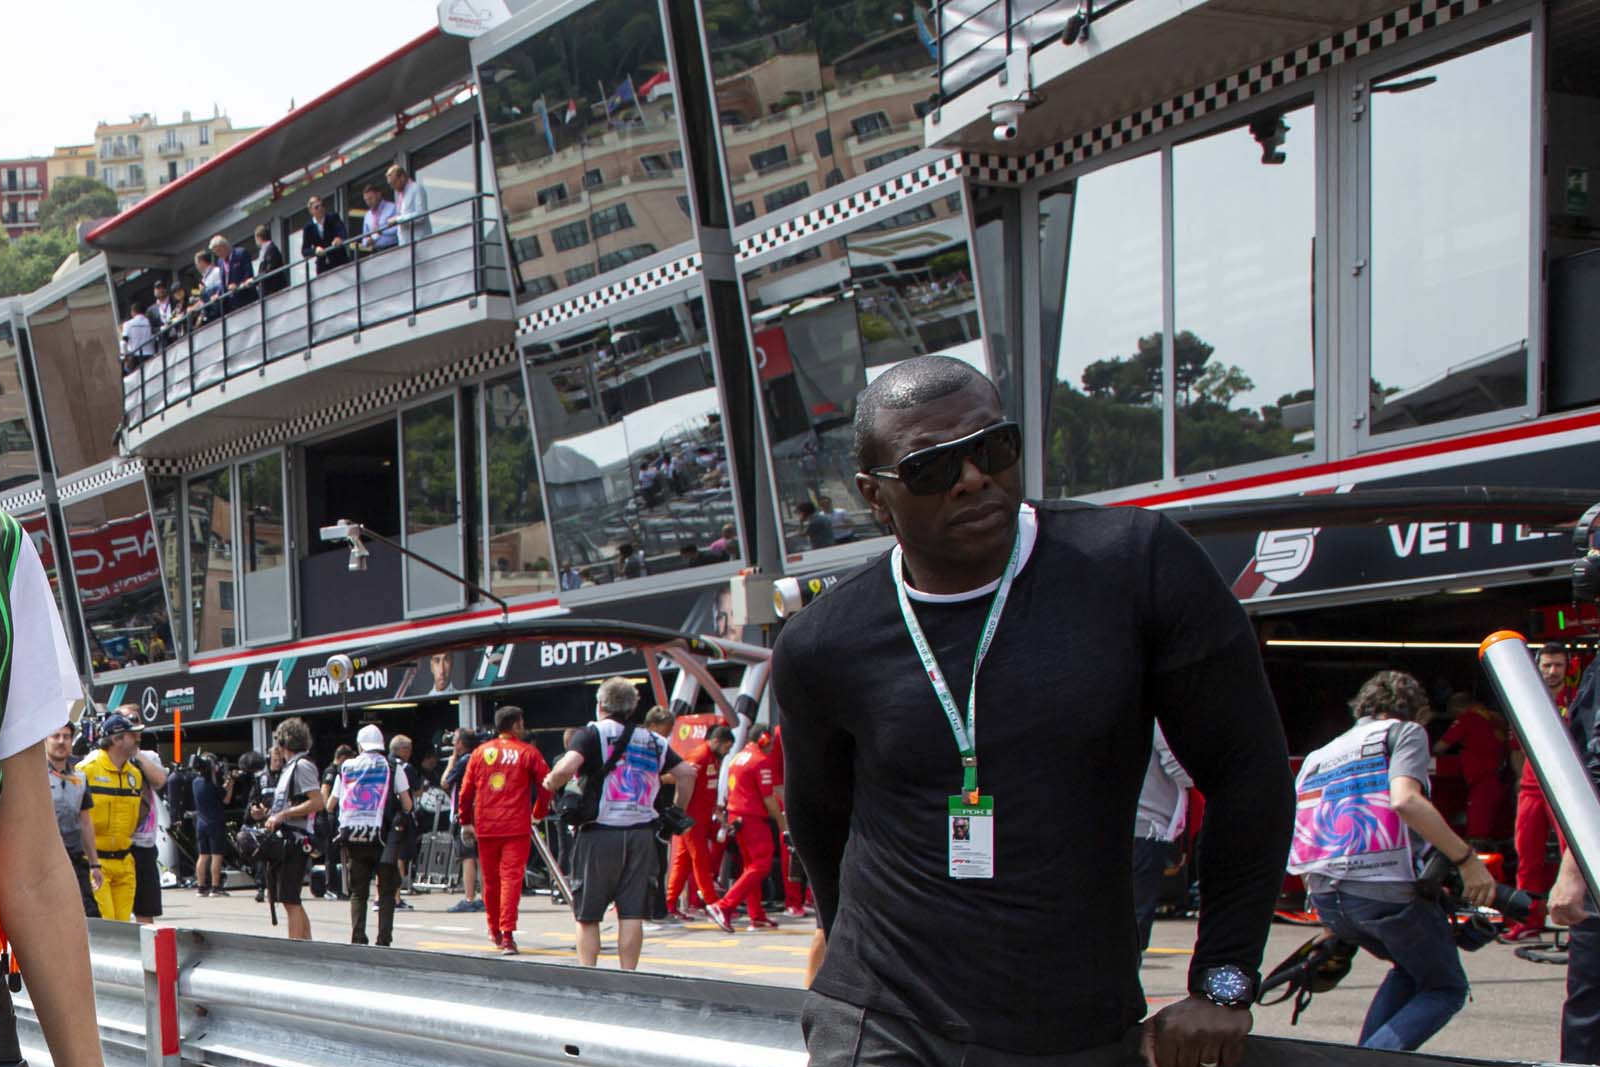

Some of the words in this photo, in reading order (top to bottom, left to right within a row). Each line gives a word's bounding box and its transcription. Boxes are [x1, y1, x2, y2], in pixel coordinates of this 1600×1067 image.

[980, 620, 997, 656] Monaco
[259, 669, 285, 704] 44
[308, 667, 388, 697] HAMLTON
